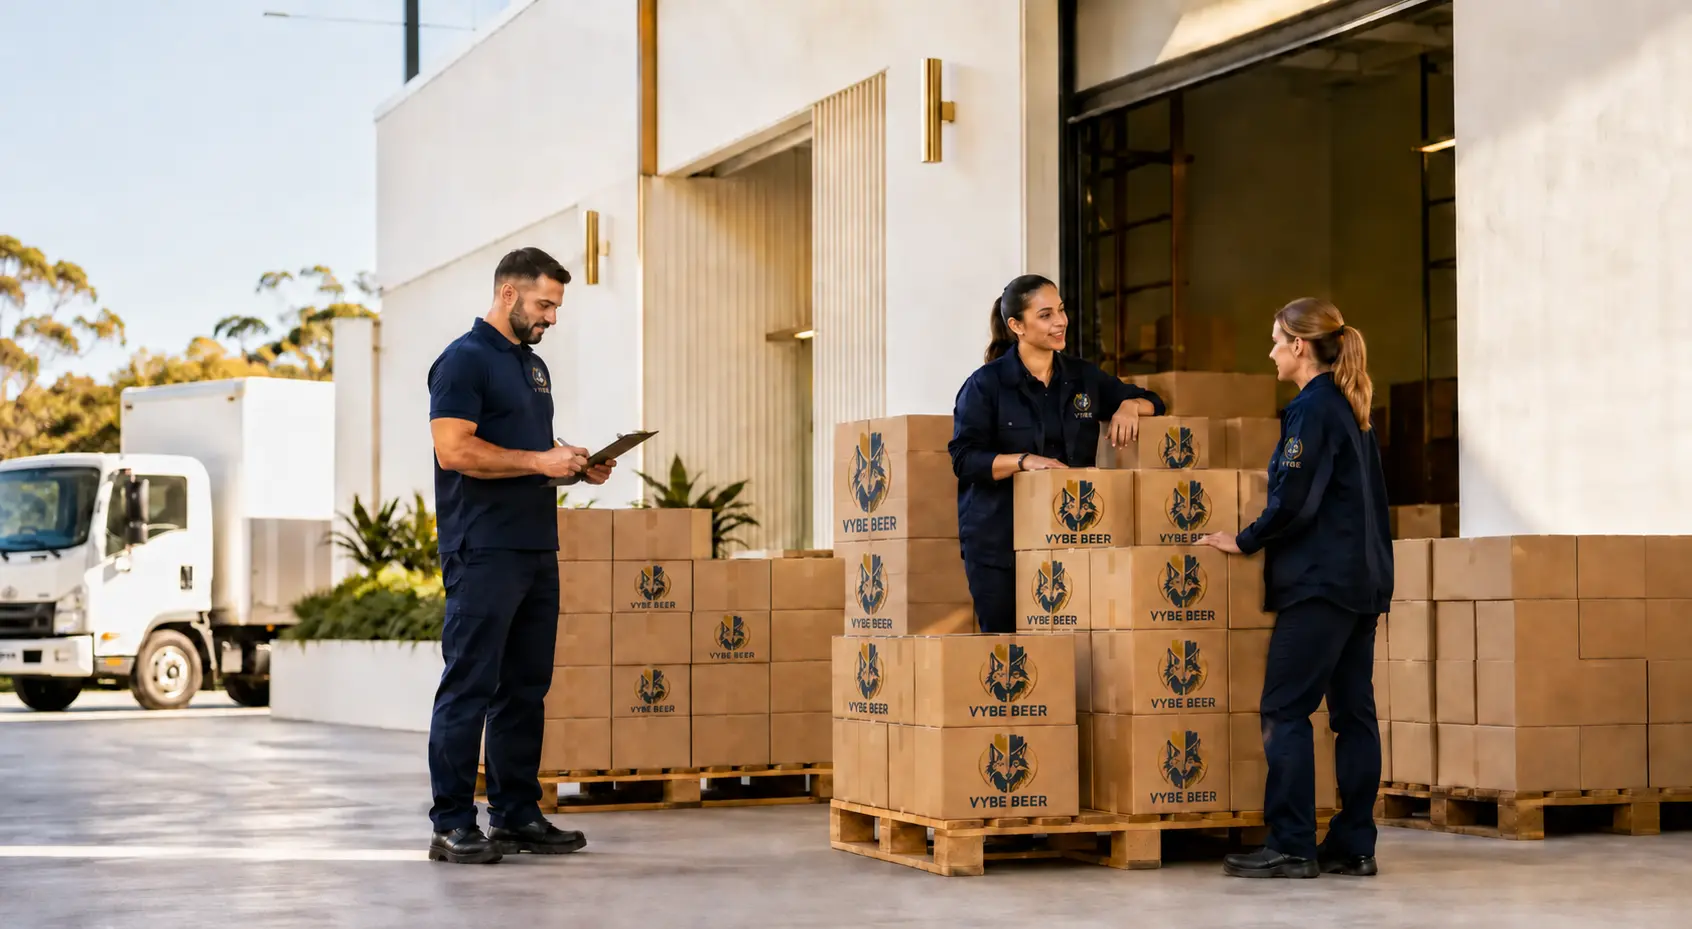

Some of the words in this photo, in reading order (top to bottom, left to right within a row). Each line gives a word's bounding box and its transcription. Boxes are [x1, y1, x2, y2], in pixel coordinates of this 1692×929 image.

[842, 518, 869, 533] VYBE
[870, 516, 897, 532] BEER
[1045, 534, 1078, 544] VYBE
[1080, 533, 1112, 544] BEER
[1160, 533, 1187, 543] VYBE
[1190, 533, 1212, 543] BE
[1026, 615, 1050, 625] VYBE
[1052, 615, 1078, 625] BEER
[1150, 611, 1183, 621] VYBE
[1185, 610, 1216, 621] BEER
[851, 618, 871, 629] VYBE
[872, 618, 893, 629] BEER
[653, 705, 675, 713] BEER
[849, 702, 868, 714] VYBE
[868, 702, 889, 715] BEER
[1150, 698, 1183, 709] VYBE
[1186, 698, 1216, 708] BEER
[970, 706, 1007, 717] VYBE
[1010, 705, 1047, 716] BEER
[970, 796, 1007, 808] VYBE
[1010, 796, 1047, 807] BEER
[1150, 792, 1184, 803] VYBE
[1186, 791, 1217, 803] BEER
